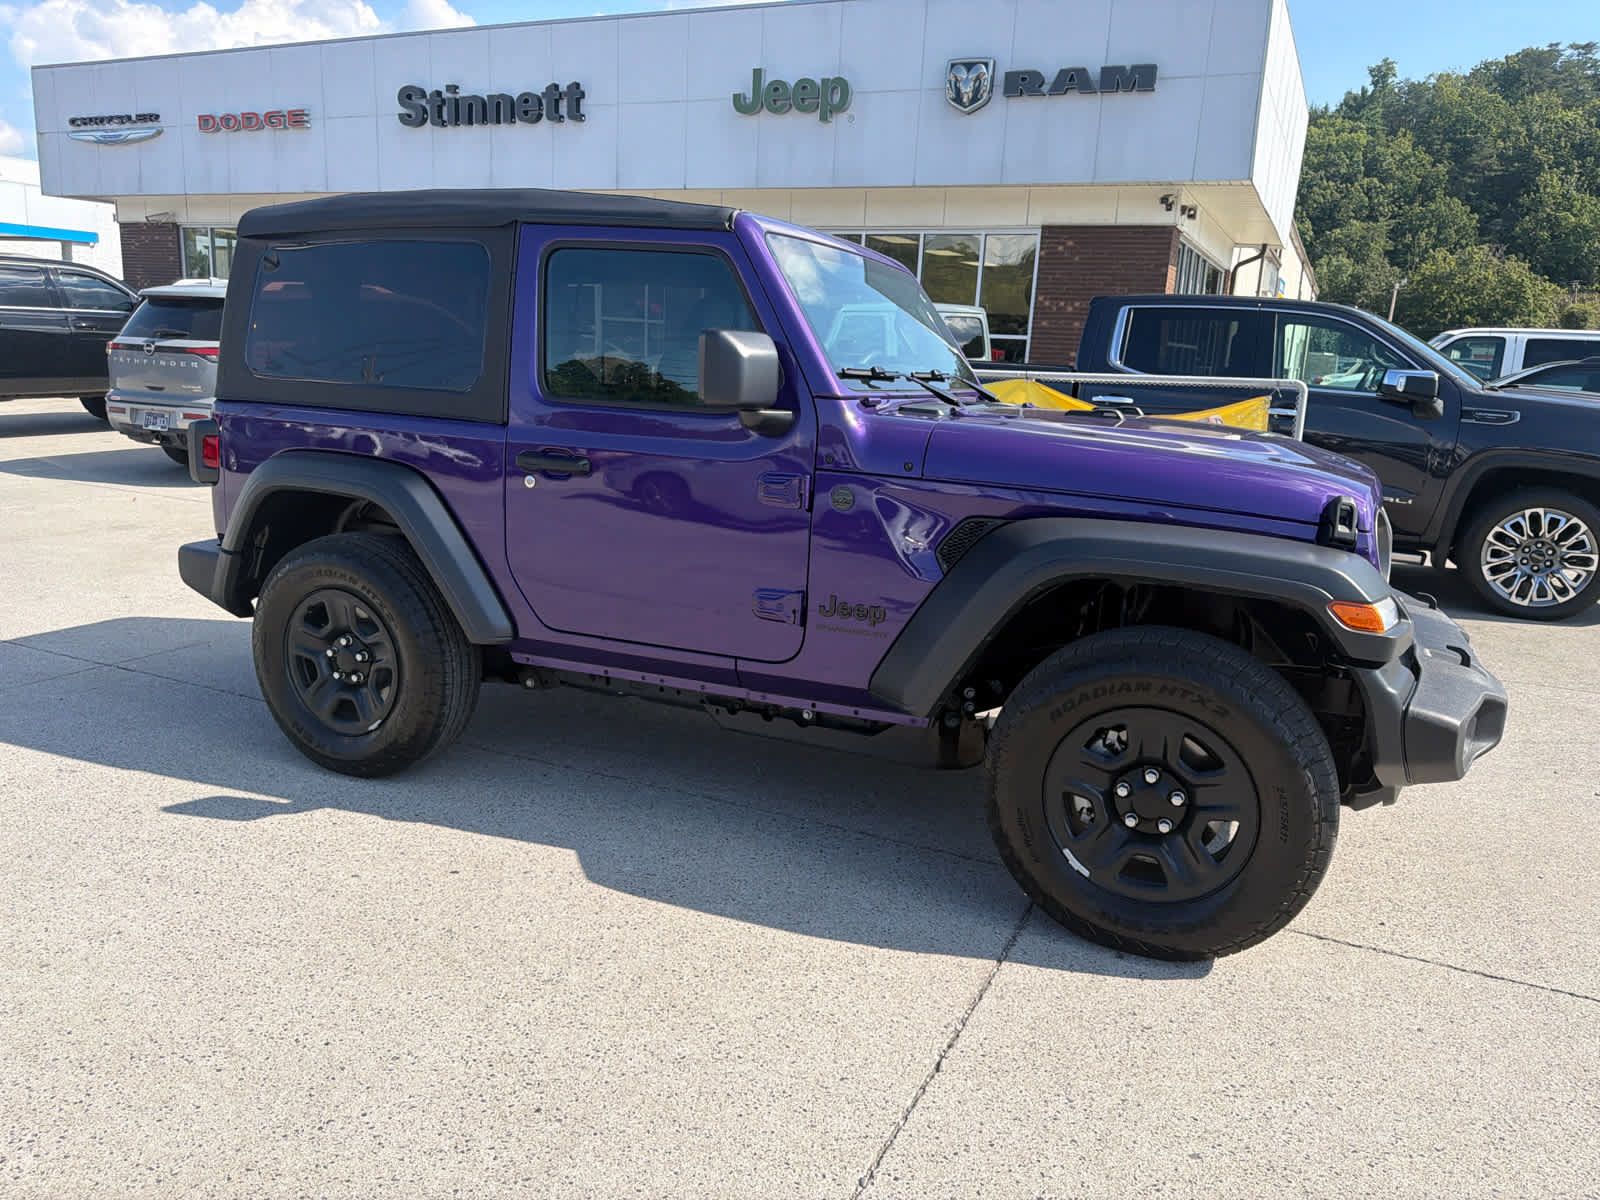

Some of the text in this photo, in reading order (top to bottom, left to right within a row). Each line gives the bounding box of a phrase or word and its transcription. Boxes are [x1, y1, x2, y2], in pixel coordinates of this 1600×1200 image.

[732, 67, 852, 124] Jeep
[1003, 63, 1159, 97] RAM
[69, 113, 161, 127] CHRYSLER
[198, 108, 312, 134] DODGE
[398, 81, 586, 128] Stinnett
[818, 594, 887, 627] Jeep
